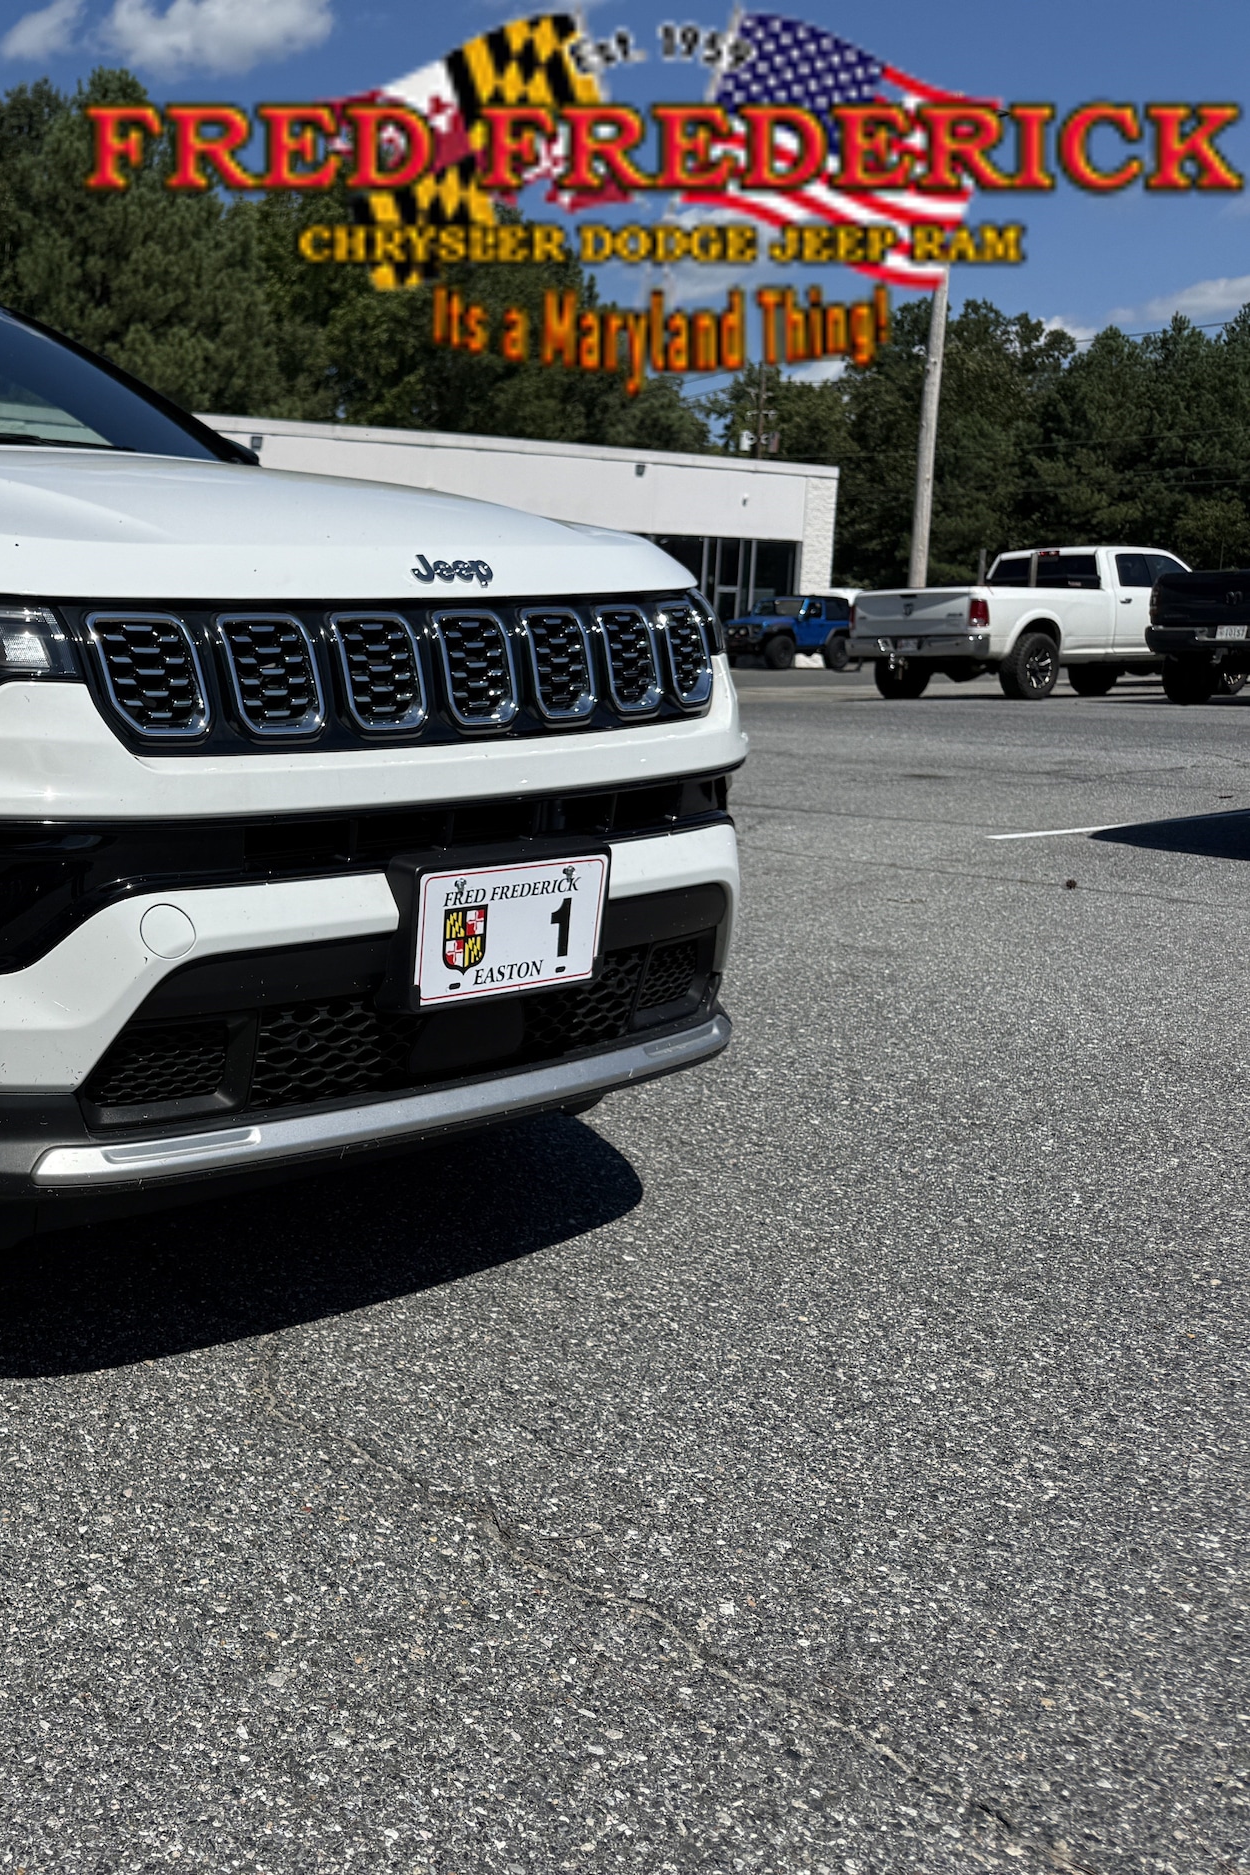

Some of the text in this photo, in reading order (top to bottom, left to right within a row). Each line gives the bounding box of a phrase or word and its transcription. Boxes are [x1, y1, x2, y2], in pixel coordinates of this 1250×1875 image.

[410, 554, 493, 588] Jeep
[443, 876, 582, 907] FRED FREDERICK
[550, 897, 573, 957] 1
[473, 959, 544, 986] EASTON
